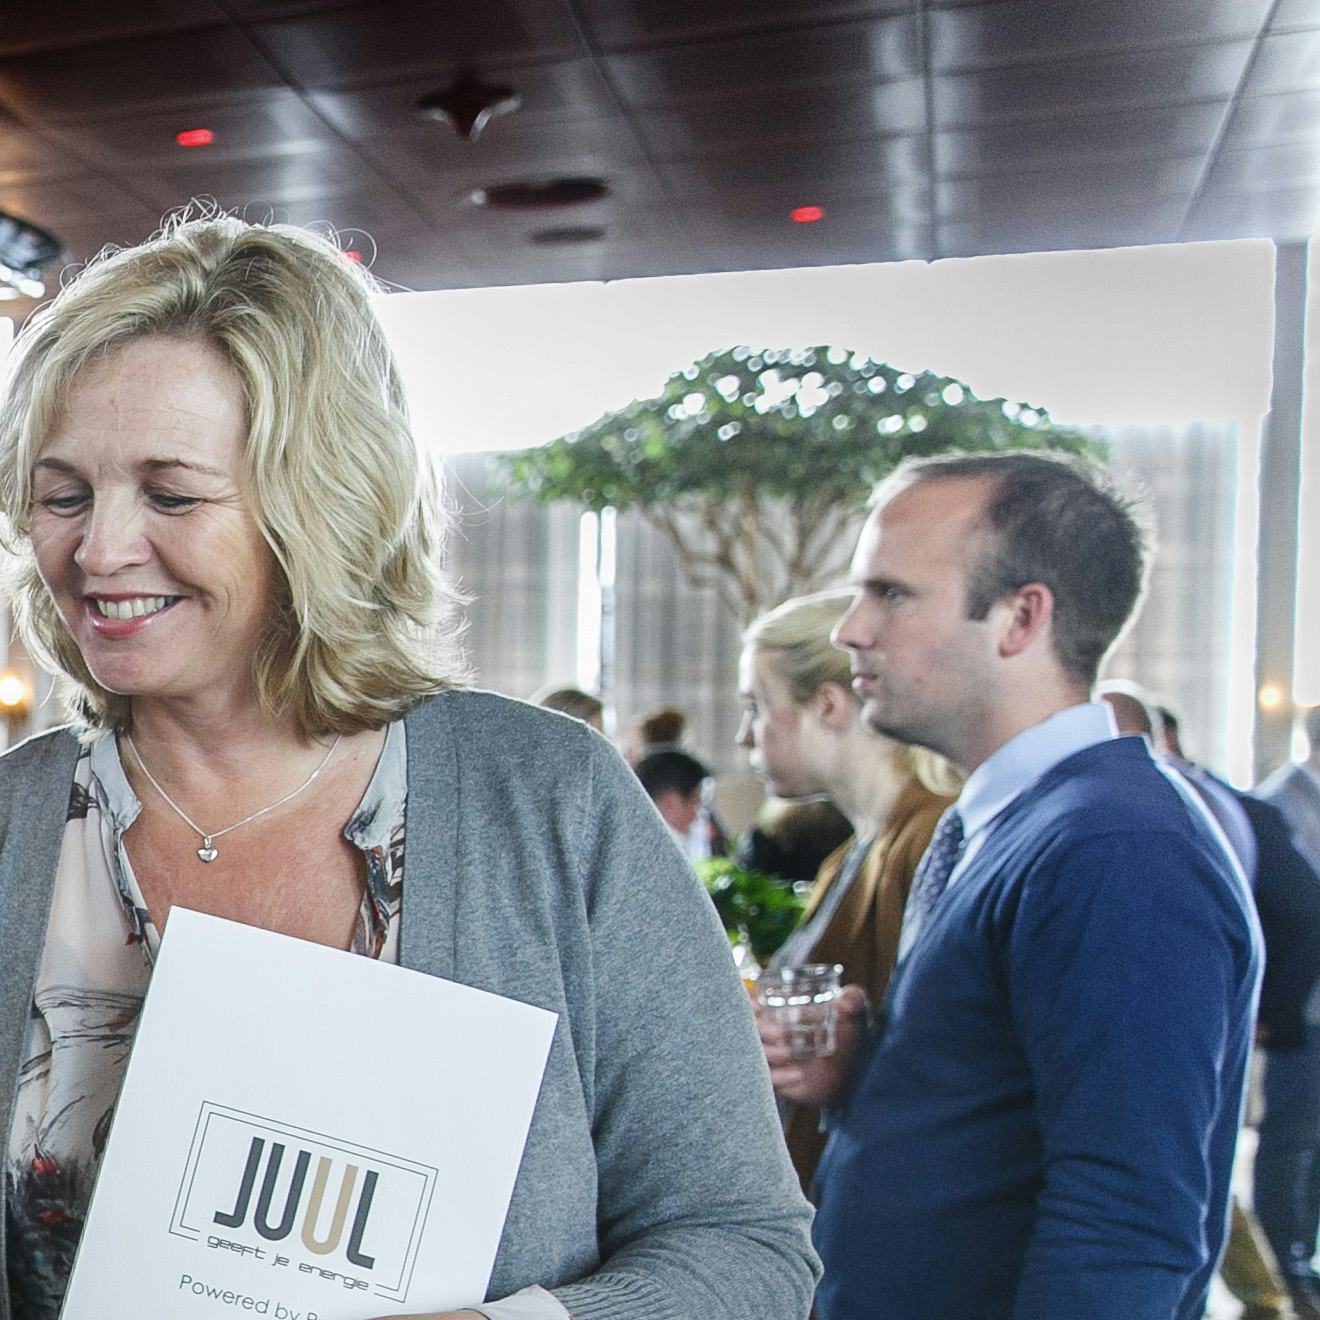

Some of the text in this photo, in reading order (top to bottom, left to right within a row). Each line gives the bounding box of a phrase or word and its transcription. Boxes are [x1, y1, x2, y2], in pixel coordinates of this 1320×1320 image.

[213, 1136, 379, 1270] JUUL
[207, 1236, 369, 1290] geeft je energie
[179, 1274, 270, 1314] Powered
